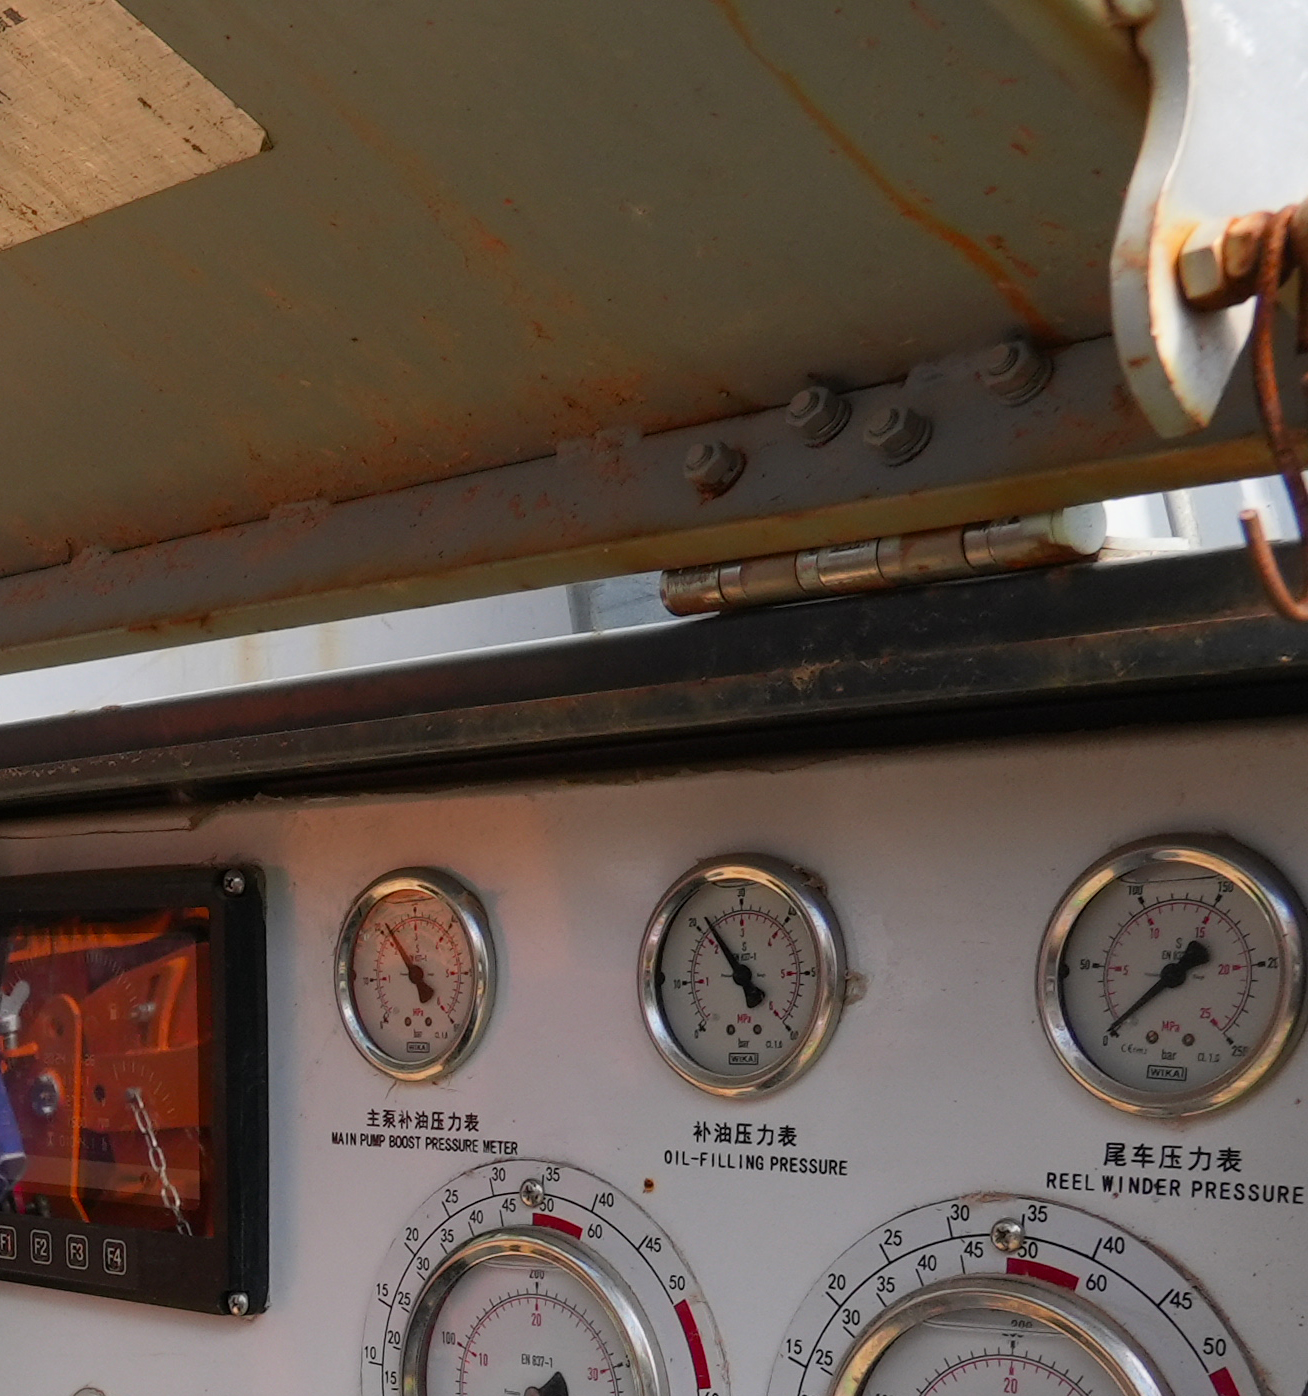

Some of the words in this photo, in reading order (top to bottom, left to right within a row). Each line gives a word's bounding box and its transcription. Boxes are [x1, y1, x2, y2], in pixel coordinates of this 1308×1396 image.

[1195, 927, 1206, 938] 15
[1080, 960, 1091, 970] 50
[1218, 964, 1230, 975] 20
[1200, 1007, 1212, 1019] 25
[1161, 1020, 1181, 1032] MPa
[1161, 1049, 1177, 1061] bar
[366, 1108, 480, 1133] 主泵补油压力表
[693, 1120, 798, 1148] 补油压力表
[332, 1131, 357, 1147] MAIN
[360, 1133, 386, 1147] PUMP
[388, 1134, 421, 1150] BOOST
[425, 1136, 478, 1154] PRESSURE
[483, 1140, 518, 1155] METER
[664, 1150, 765, 1171] OIL-FILLING
[769, 1156, 848, 1176] PRESSURE
[1103, 1142, 1242, 1173] 尾车压力表
[491, 1168, 507, 1182] 30
[545, 1168, 561, 1181] 35
[1046, 1172, 1095, 1192] REEL
[1102, 1175, 1181, 1198] WINDER
[1191, 1180, 1305, 1205] PRESSURE
[445, 1190, 459, 1204] 25
[599, 1193, 615, 1208] 40
[502, 1198, 517, 1212] 45
[539, 1198, 554, 1212] 50
[470, 1210, 484, 1224] 40
[950, 1204, 970, 1222] 30
[1027, 1205, 1048, 1223] 35
[405, 1228, 420, 1241] 20
[440, 1230, 455, 1244] 35
[587, 1225, 603, 1239] 60
[884, 1230, 903, 1246] 25
[0, 1231, 14, 1254] F1
[34, 1235, 48, 1258] F2
[646, 1237, 662, 1252] 45
[964, 1241, 984, 1258] 45
[1017, 1241, 1039, 1259] 50
[1103, 1237, 1125, 1255] 40
[69, 1240, 84, 1263] F3
[106, 1245, 122, 1269] F4
[416, 1258, 431, 1272] 30
[917, 1255, 937, 1272] 40
[375, 1284, 390, 1297] 15
[669, 1276, 686, 1291] 50
[827, 1275, 846, 1291] 20
[876, 1276, 896, 1294] 35
[1085, 1274, 1108, 1292] 60
[398, 1292, 412, 1306] 25
[1171, 1291, 1193, 1310] 45
[531, 1313, 542, 1327] 20
[842, 1309, 861, 1326] 30
[387, 1331, 402, 1345] 20
[441, 1331, 456, 1346] 100
[364, 1346, 378, 1360] 10
[786, 1340, 803, 1356] 15
[1203, 1338, 1227, 1356] 50
[479, 1354, 489, 1367] 10
[521, 1354, 531, 1366] EN
[815, 1349, 834, 1366] 25
[384, 1371, 398, 1385] 15
[587, 1368, 599, 1381] 30
[1003, 1378, 1018, 1394] 20
